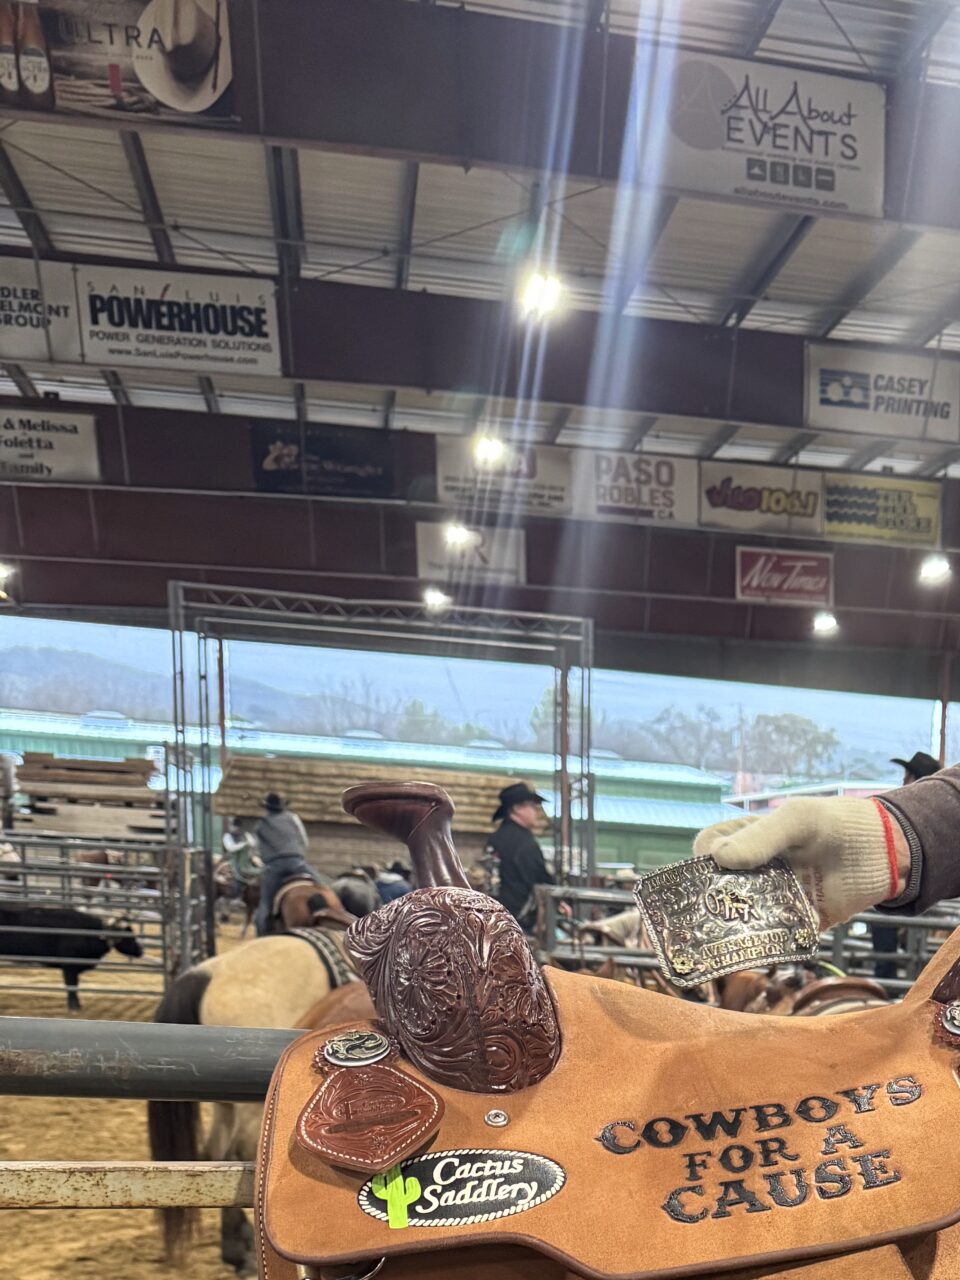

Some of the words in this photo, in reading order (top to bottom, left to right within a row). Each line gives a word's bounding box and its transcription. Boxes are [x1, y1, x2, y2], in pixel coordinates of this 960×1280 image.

[725, 116, 859, 161] EVENTS
[88, 293, 269, 339] POWERHOUSE
[89, 330, 130, 342] POWER
[135, 333, 208, 348] GENERATION
[211, 339, 272, 353] SOLUTIONS
[873, 374, 929, 396] CASEY
[873, 395, 951, 420] PRINTING
[18, 418, 79, 435] Melissa
[0, 434, 55, 451] oletta
[594, 454, 675, 488] PASO
[595, 484, 675, 509] ROBLES
[682, 1136, 800, 1182] FOR
[819, 1124, 865, 1155] A
[432, 1157, 525, 1186] Cactus
[415, 1177, 538, 1214] Saddlery
[660, 1150, 902, 1224] CAUSE
